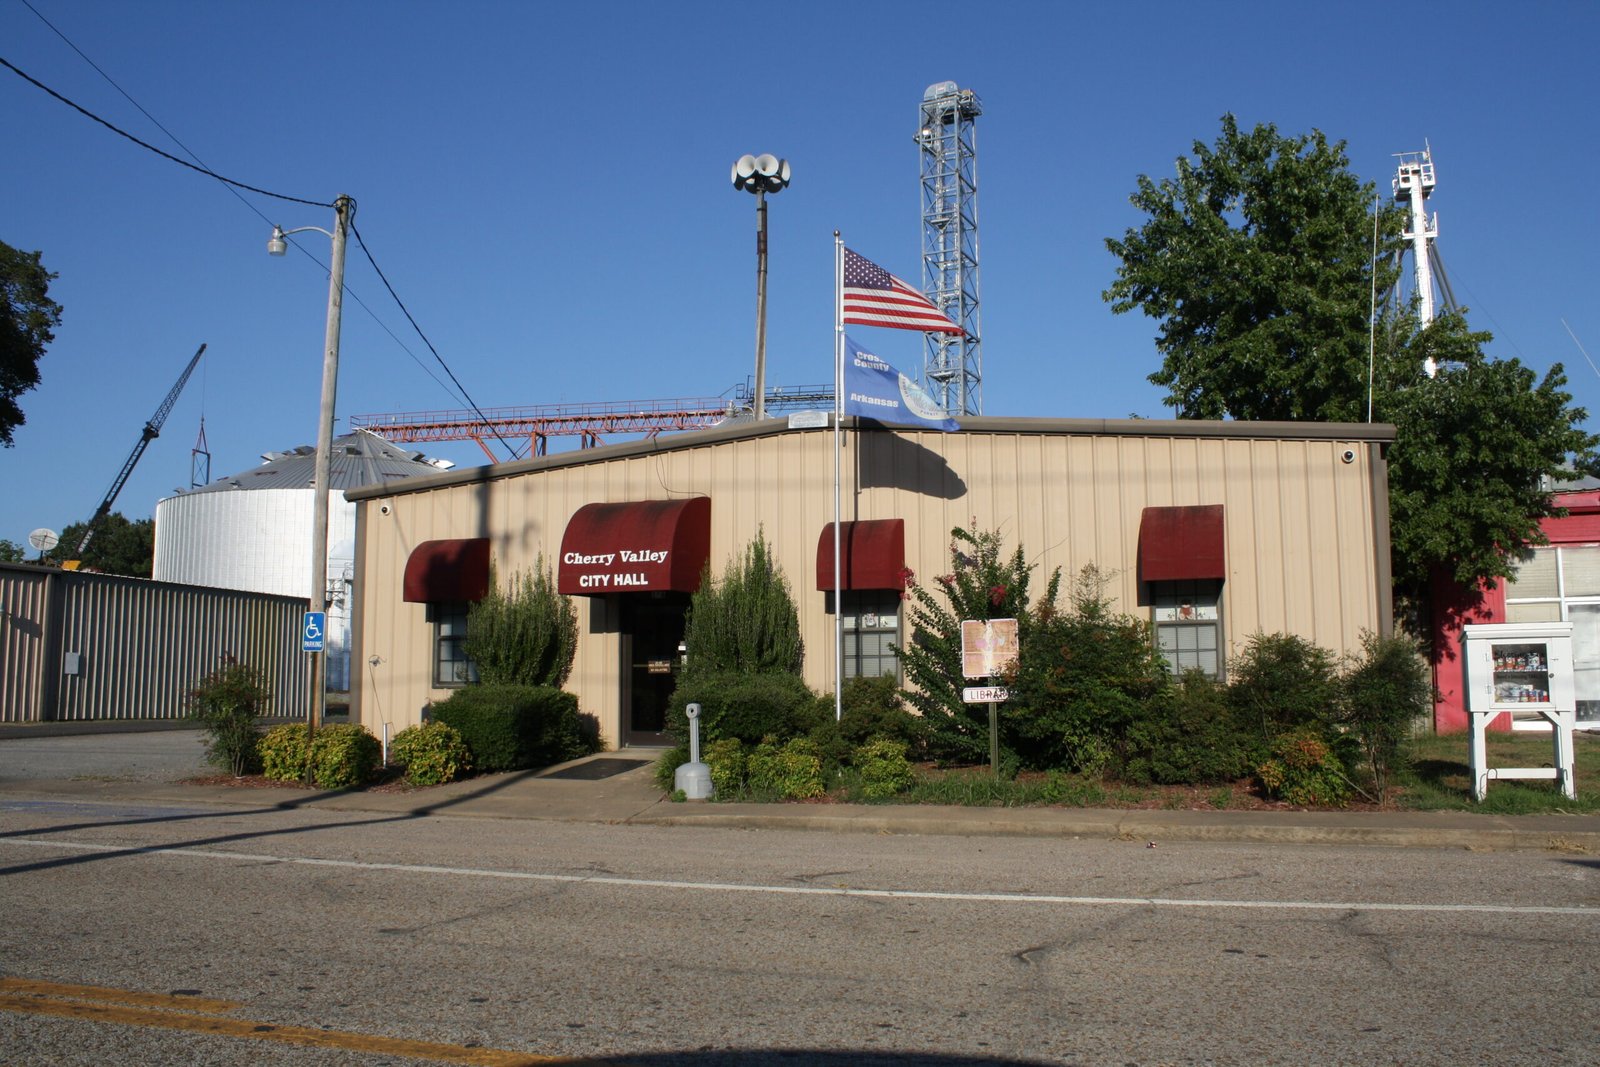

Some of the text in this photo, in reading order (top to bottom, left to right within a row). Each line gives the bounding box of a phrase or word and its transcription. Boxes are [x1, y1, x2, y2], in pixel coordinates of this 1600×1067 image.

[856, 351, 885, 363] Cros
[854, 358, 889, 372] County
[850, 392, 899, 408] Arkansas
[563, 549, 669, 566] Cherry Valley
[579, 573, 649, 587] CITY HALL
[304, 640, 323, 648] PARKING
